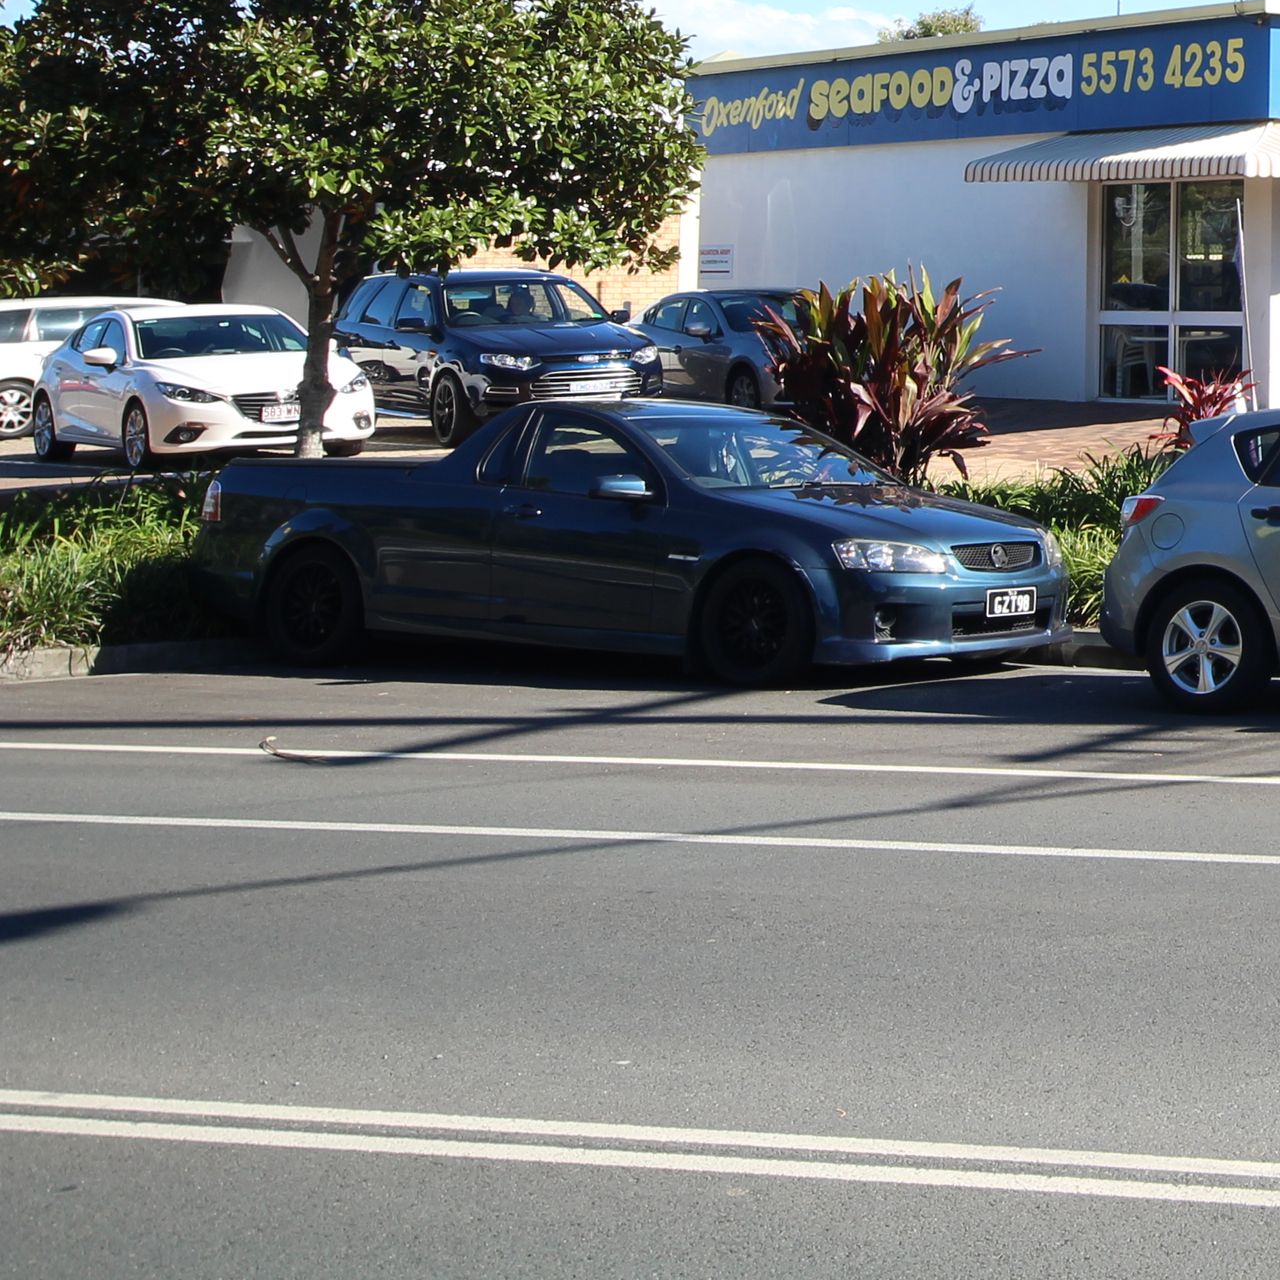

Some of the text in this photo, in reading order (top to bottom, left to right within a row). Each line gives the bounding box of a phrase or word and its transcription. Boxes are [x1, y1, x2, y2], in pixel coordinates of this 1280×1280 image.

[701, 78, 804, 137] Oxenford
[1080, 47, 1155, 96] 5573
[1163, 37, 1246, 90] 4235
